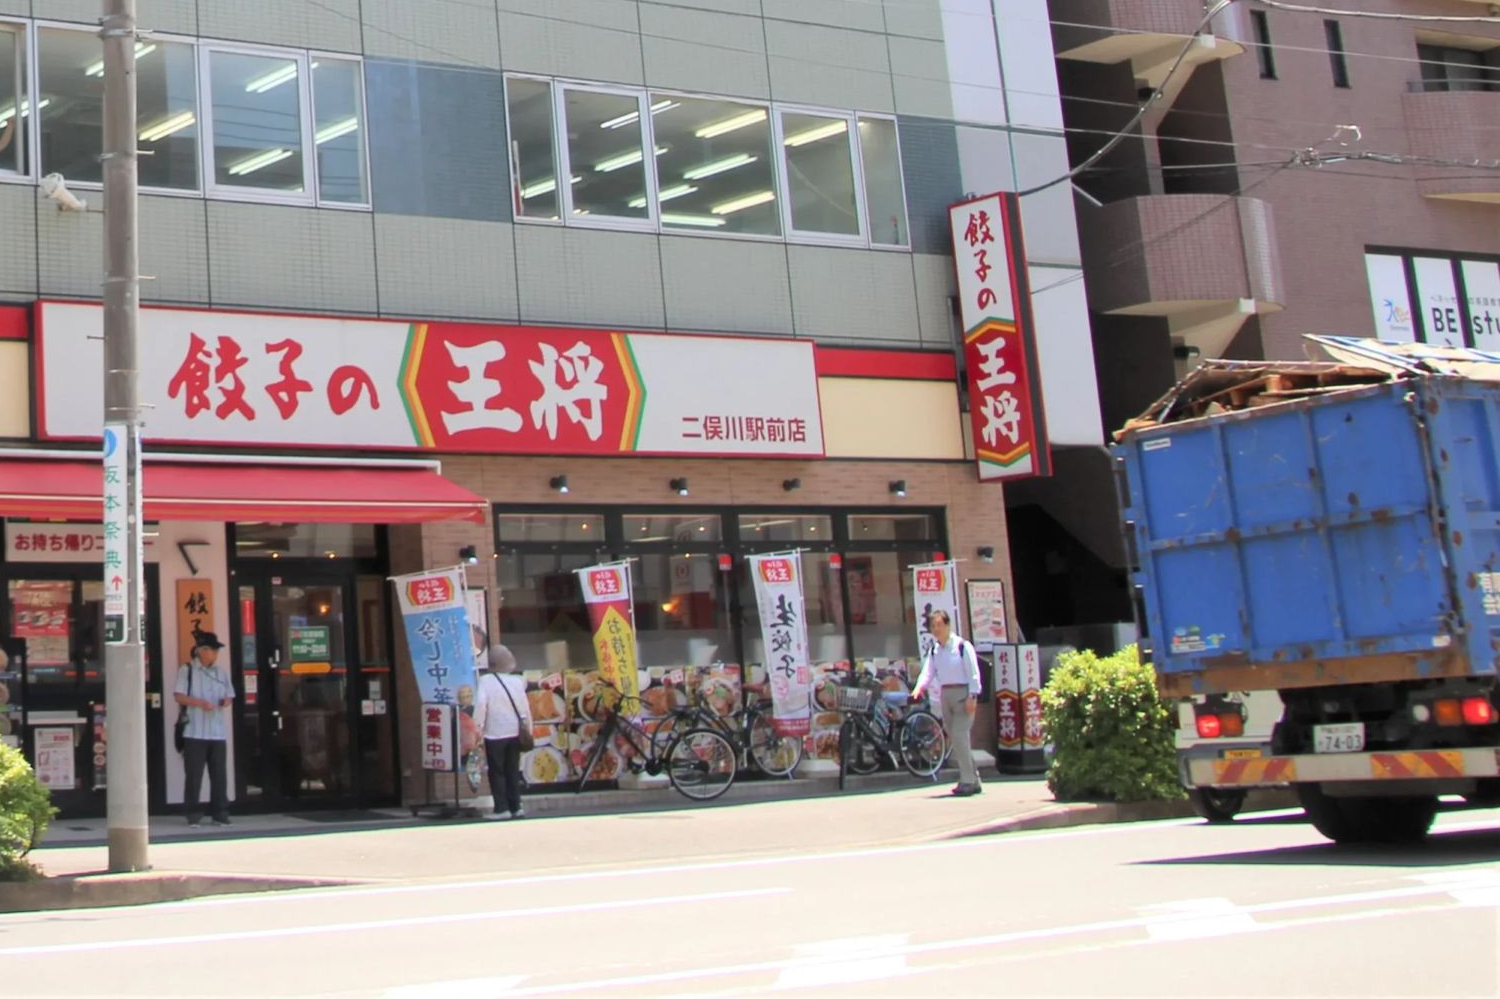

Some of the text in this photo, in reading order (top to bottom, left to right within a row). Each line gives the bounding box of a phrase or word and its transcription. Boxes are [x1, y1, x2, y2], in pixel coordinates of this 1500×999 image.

[964, 211, 997, 310] 餃子の
[1431, 307, 1458, 333] BE
[168, 332, 807, 443] 餃子の 王将 二俣川駅前店
[975, 337, 1021, 446] 王将
[426, 708, 443, 756] 営業中
